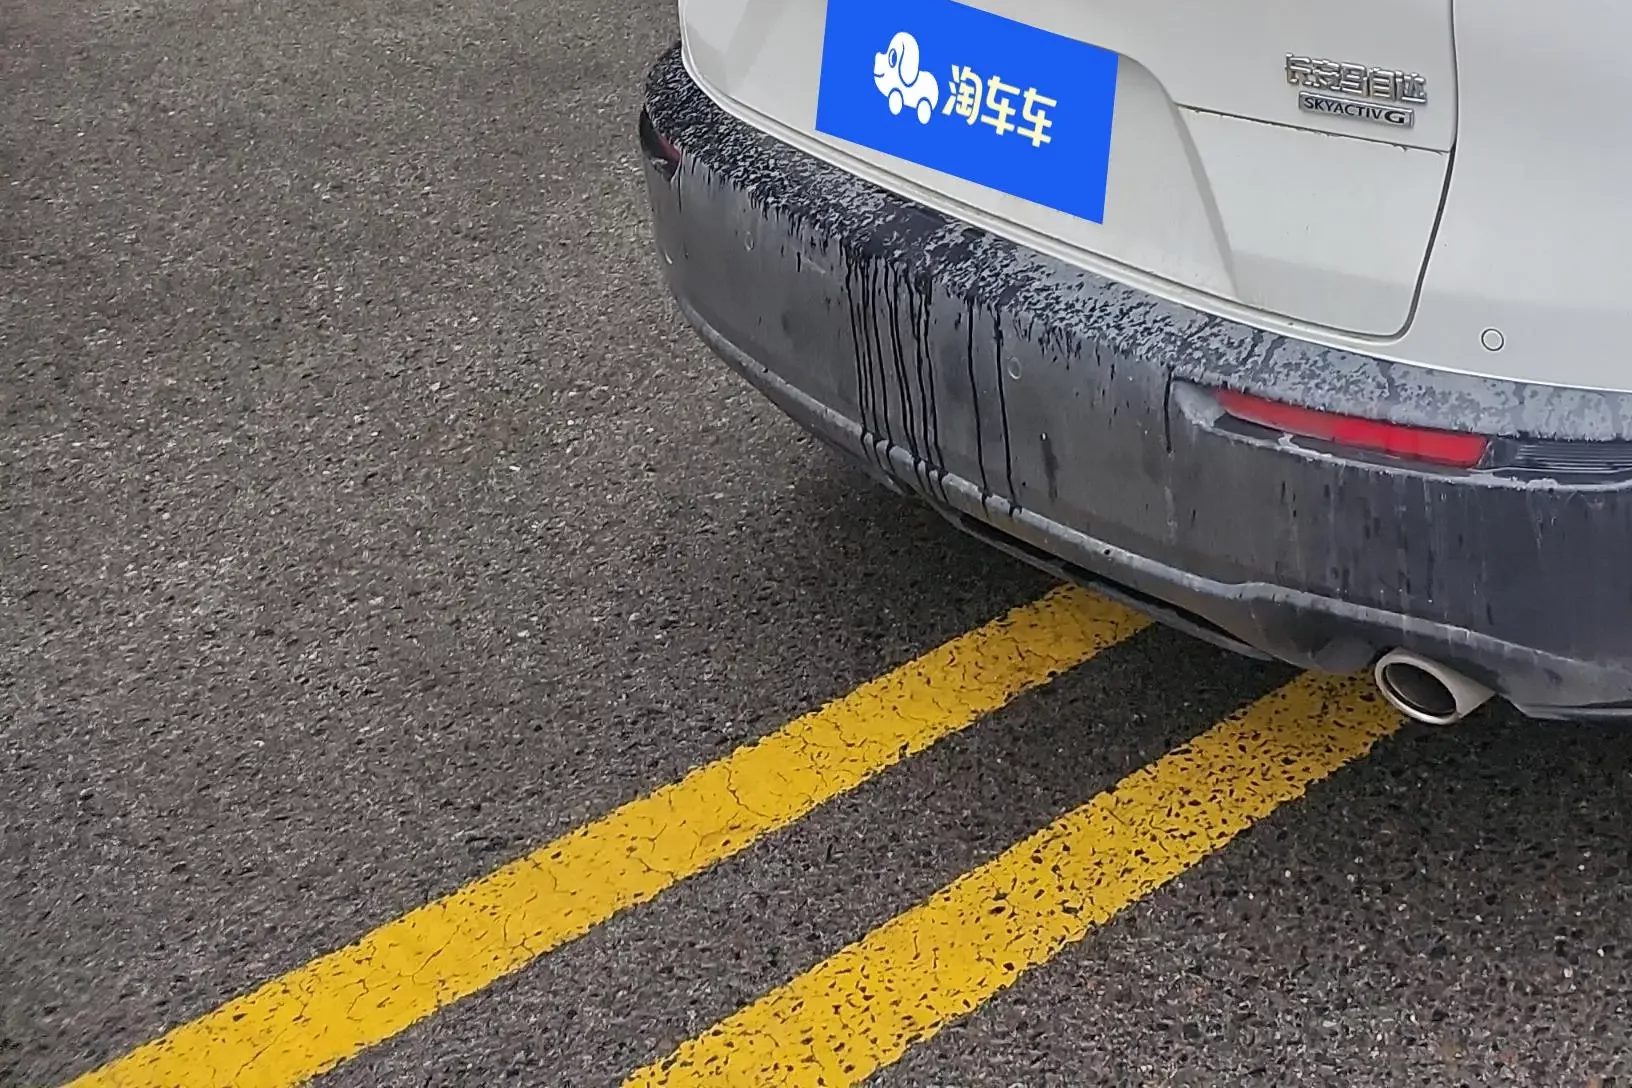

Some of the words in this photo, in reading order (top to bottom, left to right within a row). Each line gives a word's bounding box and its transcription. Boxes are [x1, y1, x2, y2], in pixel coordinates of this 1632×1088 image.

[1285, 52, 1428, 105] 长安马自达
